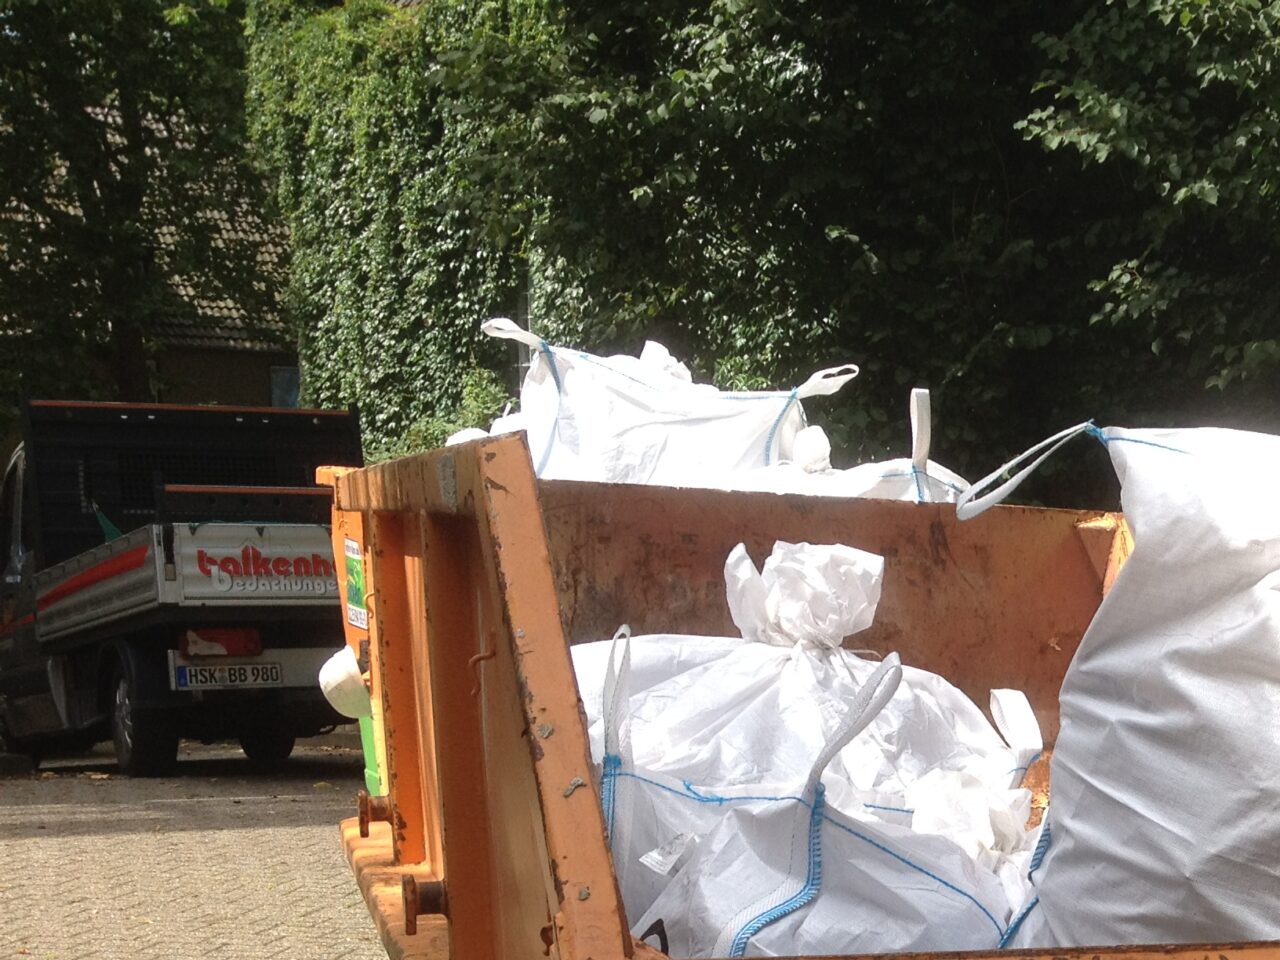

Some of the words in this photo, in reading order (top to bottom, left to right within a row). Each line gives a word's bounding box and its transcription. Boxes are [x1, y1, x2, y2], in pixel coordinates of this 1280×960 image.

[211, 565, 338, 594] bedachunge
[188, 667, 219, 685] HSK
[228, 666, 248, 684] BB
[251, 665, 280, 683] 980
